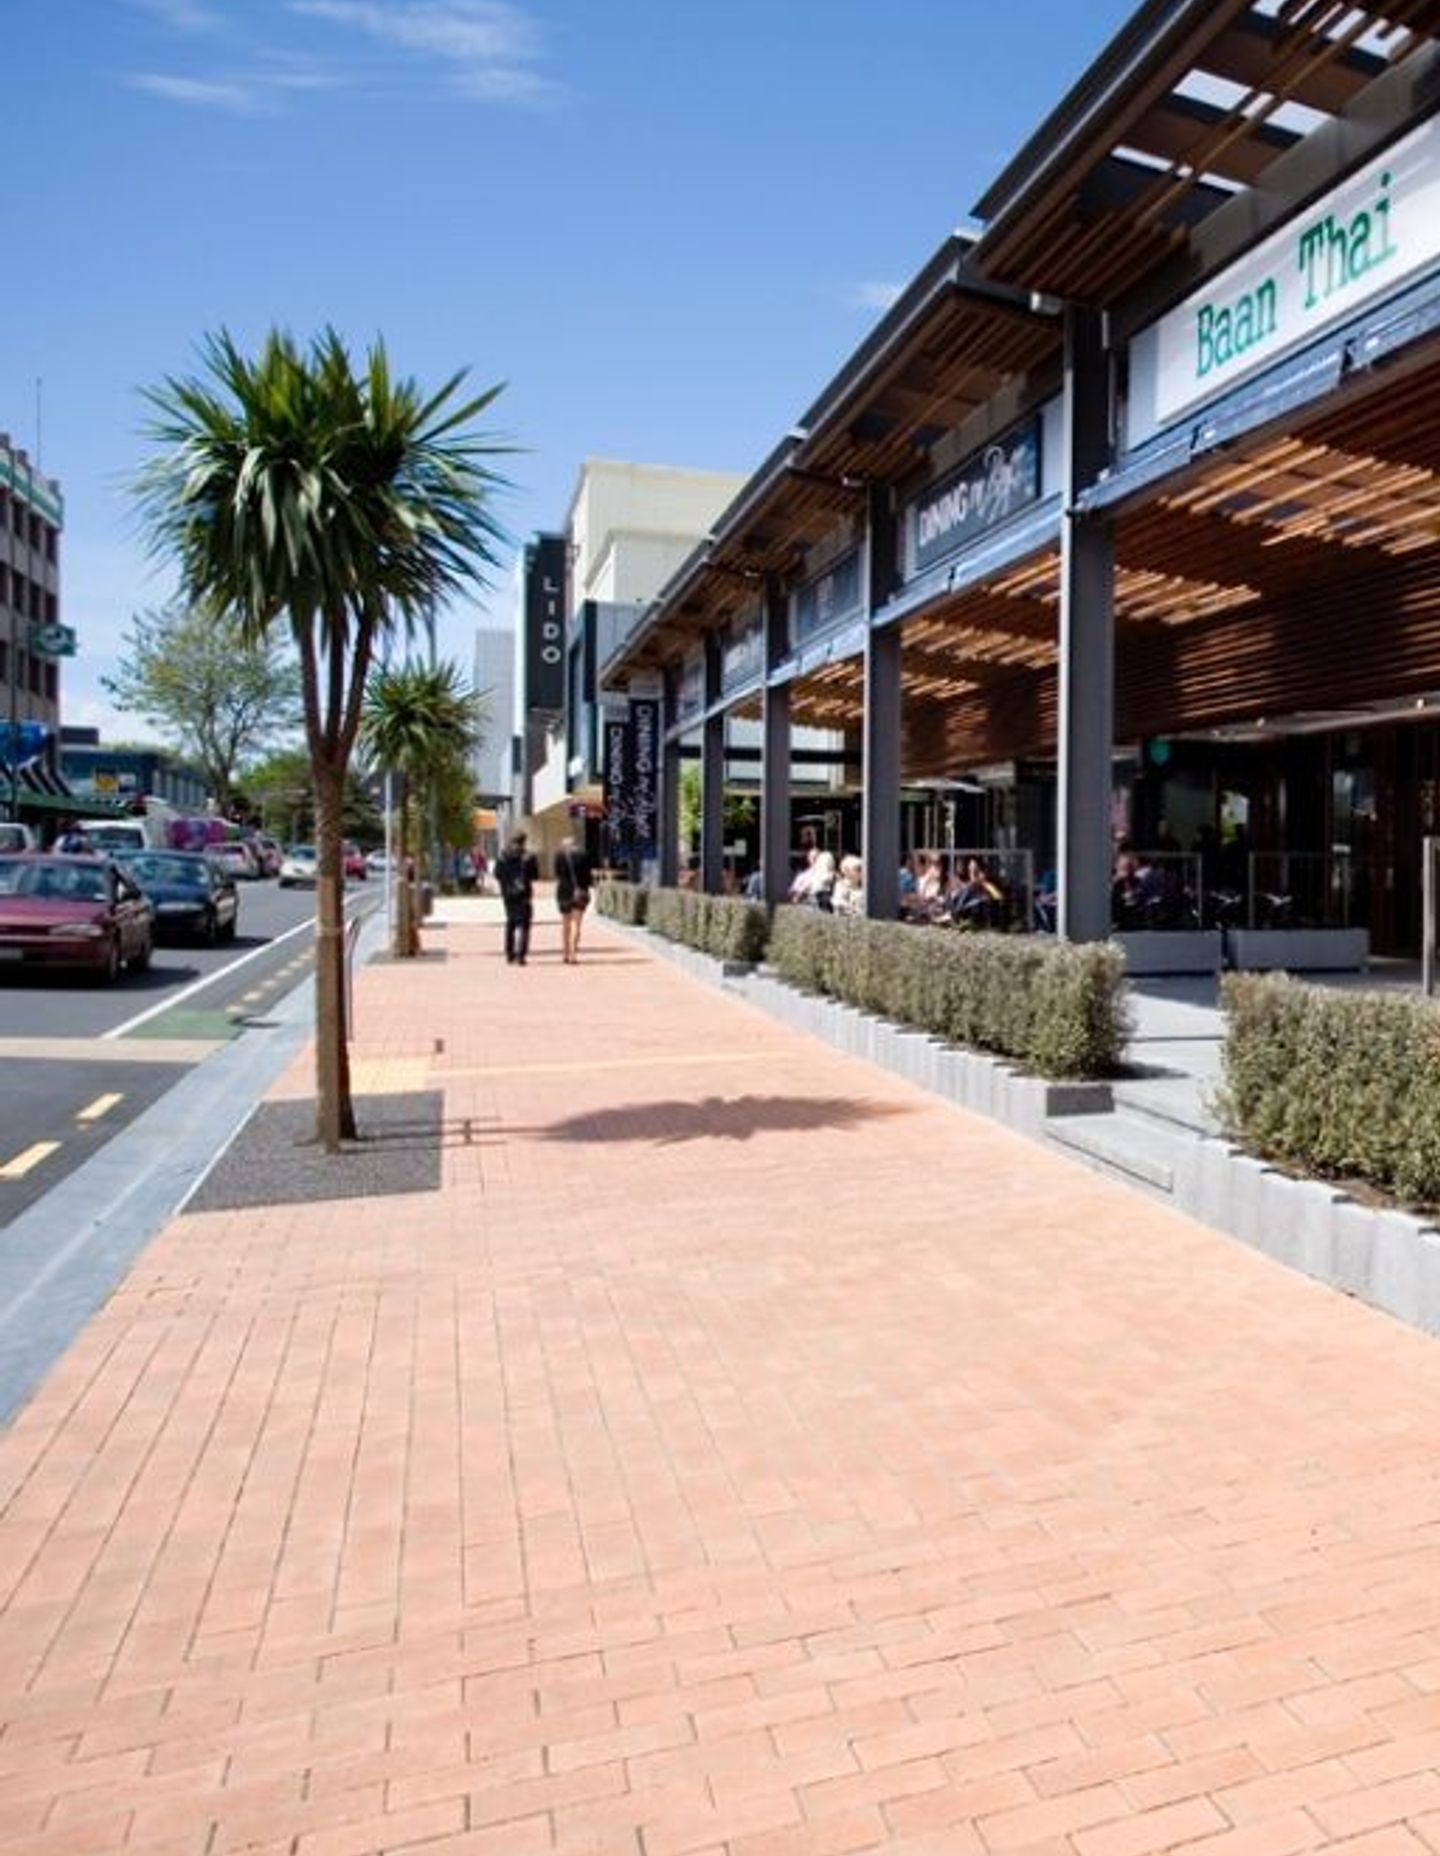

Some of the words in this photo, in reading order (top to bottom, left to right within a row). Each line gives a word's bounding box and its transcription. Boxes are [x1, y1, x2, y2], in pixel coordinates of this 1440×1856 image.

[1197, 277, 1276, 377] Baan
[1298, 172, 1397, 309] Thai
[918, 482, 967, 547] DINING
[543, 577, 562, 664] LIDO
[635, 703, 654, 775] DINING
